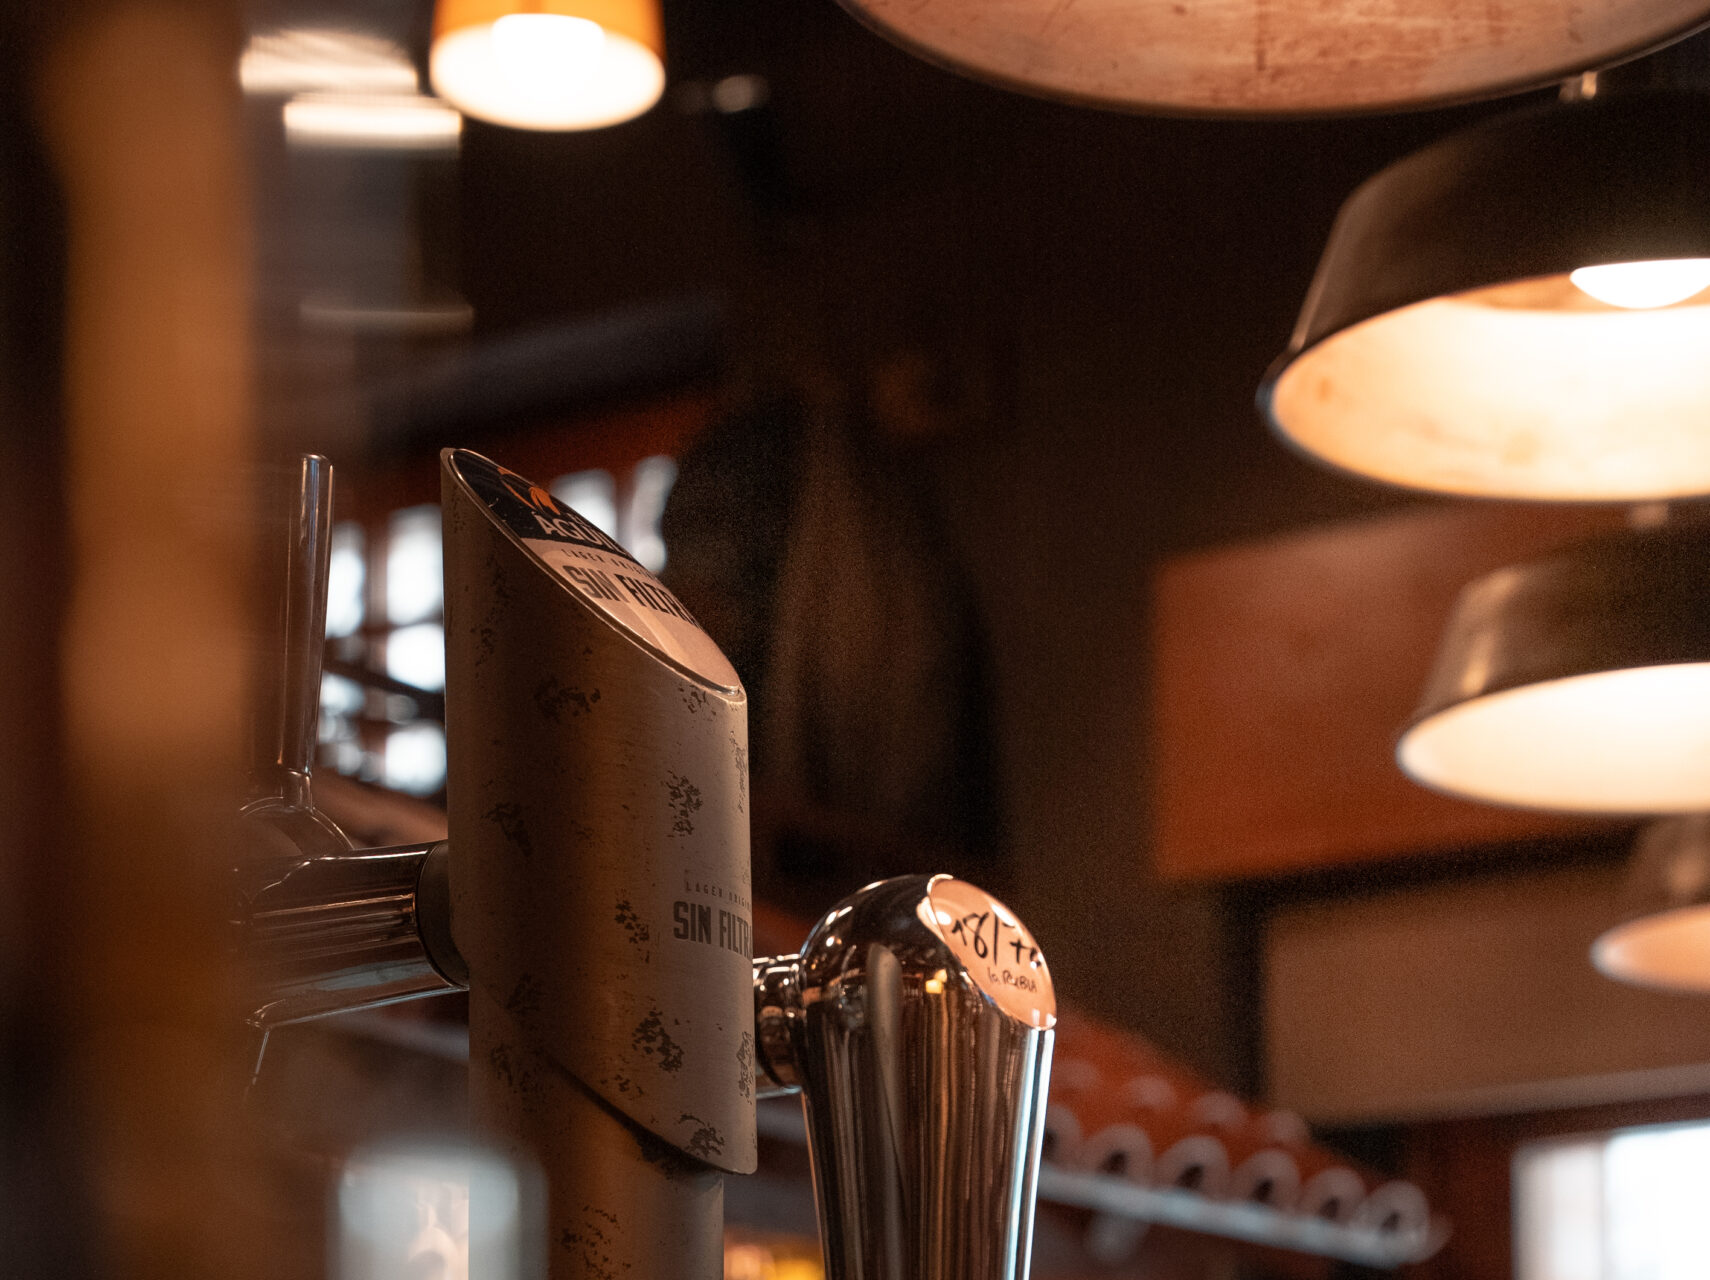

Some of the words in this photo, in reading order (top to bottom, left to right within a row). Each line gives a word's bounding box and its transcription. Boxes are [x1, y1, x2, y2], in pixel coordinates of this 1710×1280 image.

[562, 565, 631, 603] SIN
[614, 573, 702, 629] FILTR
[673, 901, 711, 945] SIN
[719, 909, 752, 959] FILTR
